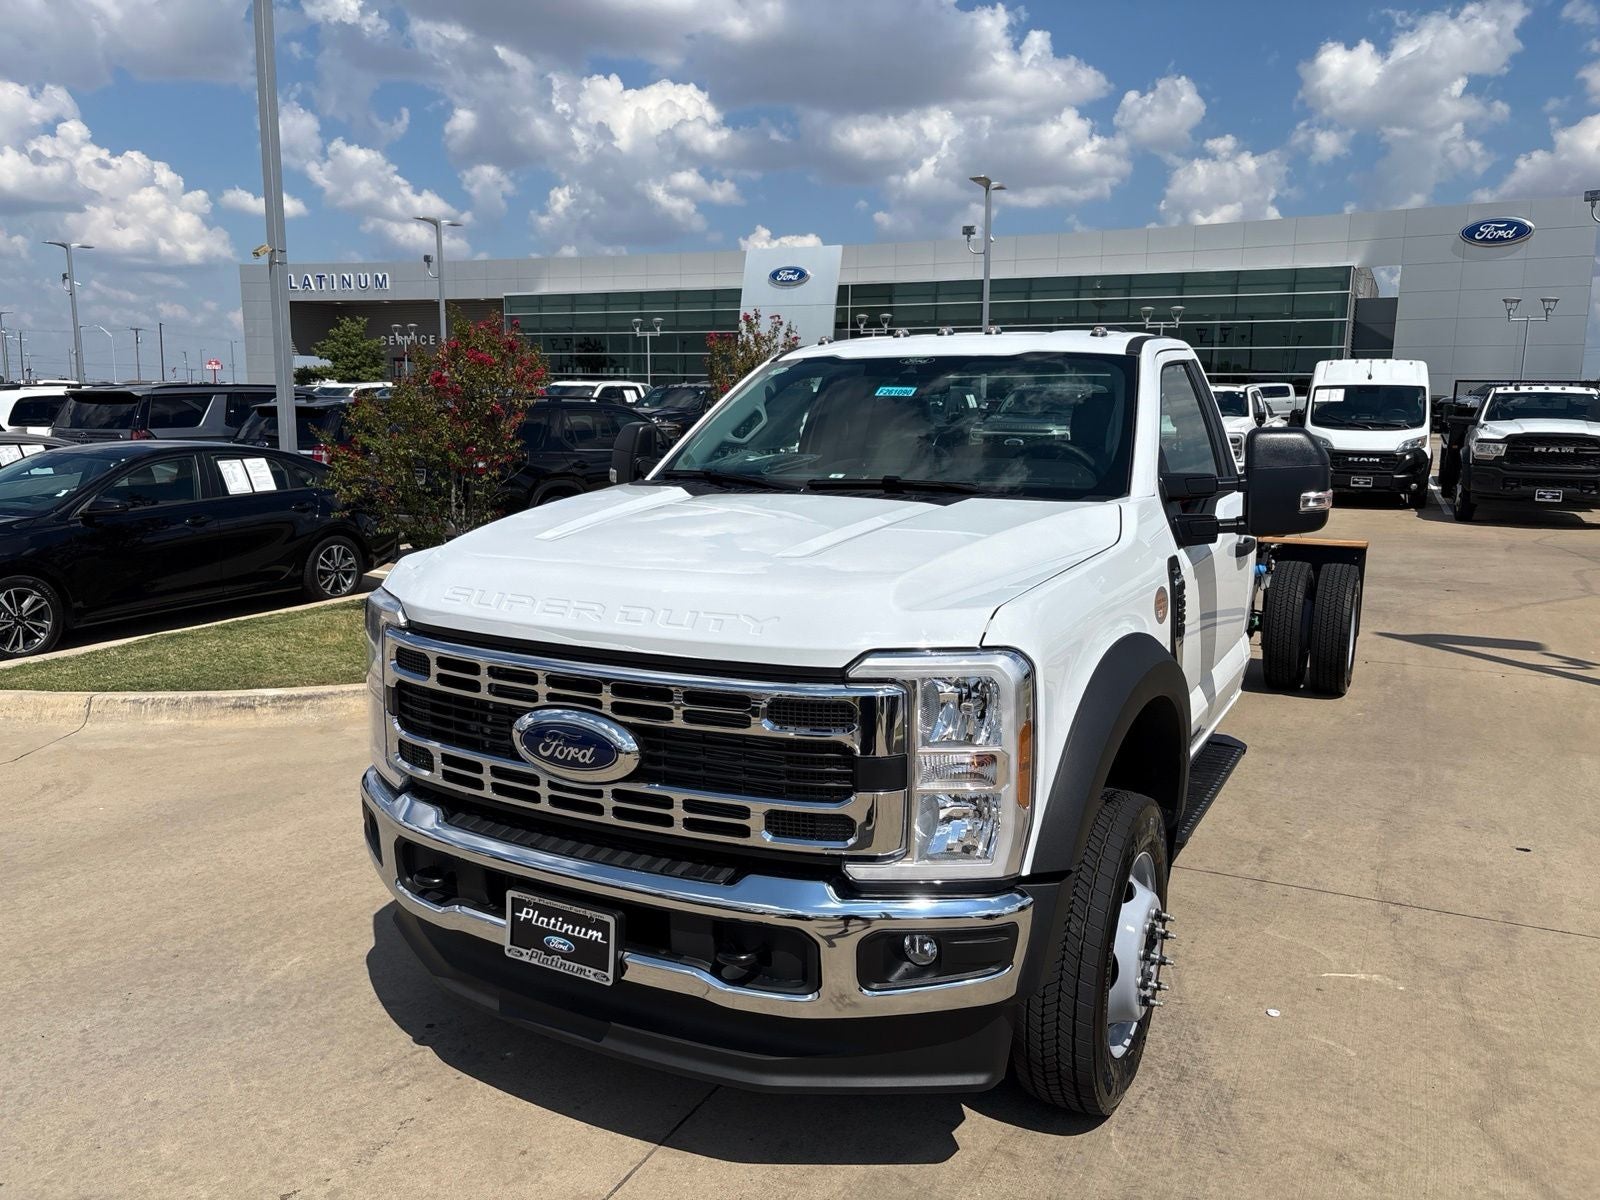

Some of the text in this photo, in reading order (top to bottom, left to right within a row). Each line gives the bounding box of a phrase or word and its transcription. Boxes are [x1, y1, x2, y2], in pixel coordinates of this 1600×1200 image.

[1474, 223, 1518, 240] Ford
[287, 272, 390, 291] LATINUM
[776, 269, 800, 281] Ford
[442, 585, 781, 636] SUPER DUTY
[538, 729, 596, 764] Ford
[515, 907, 608, 944] Platinum
[548, 938, 569, 951] Ford
[528, 949, 592, 977] Platinum
